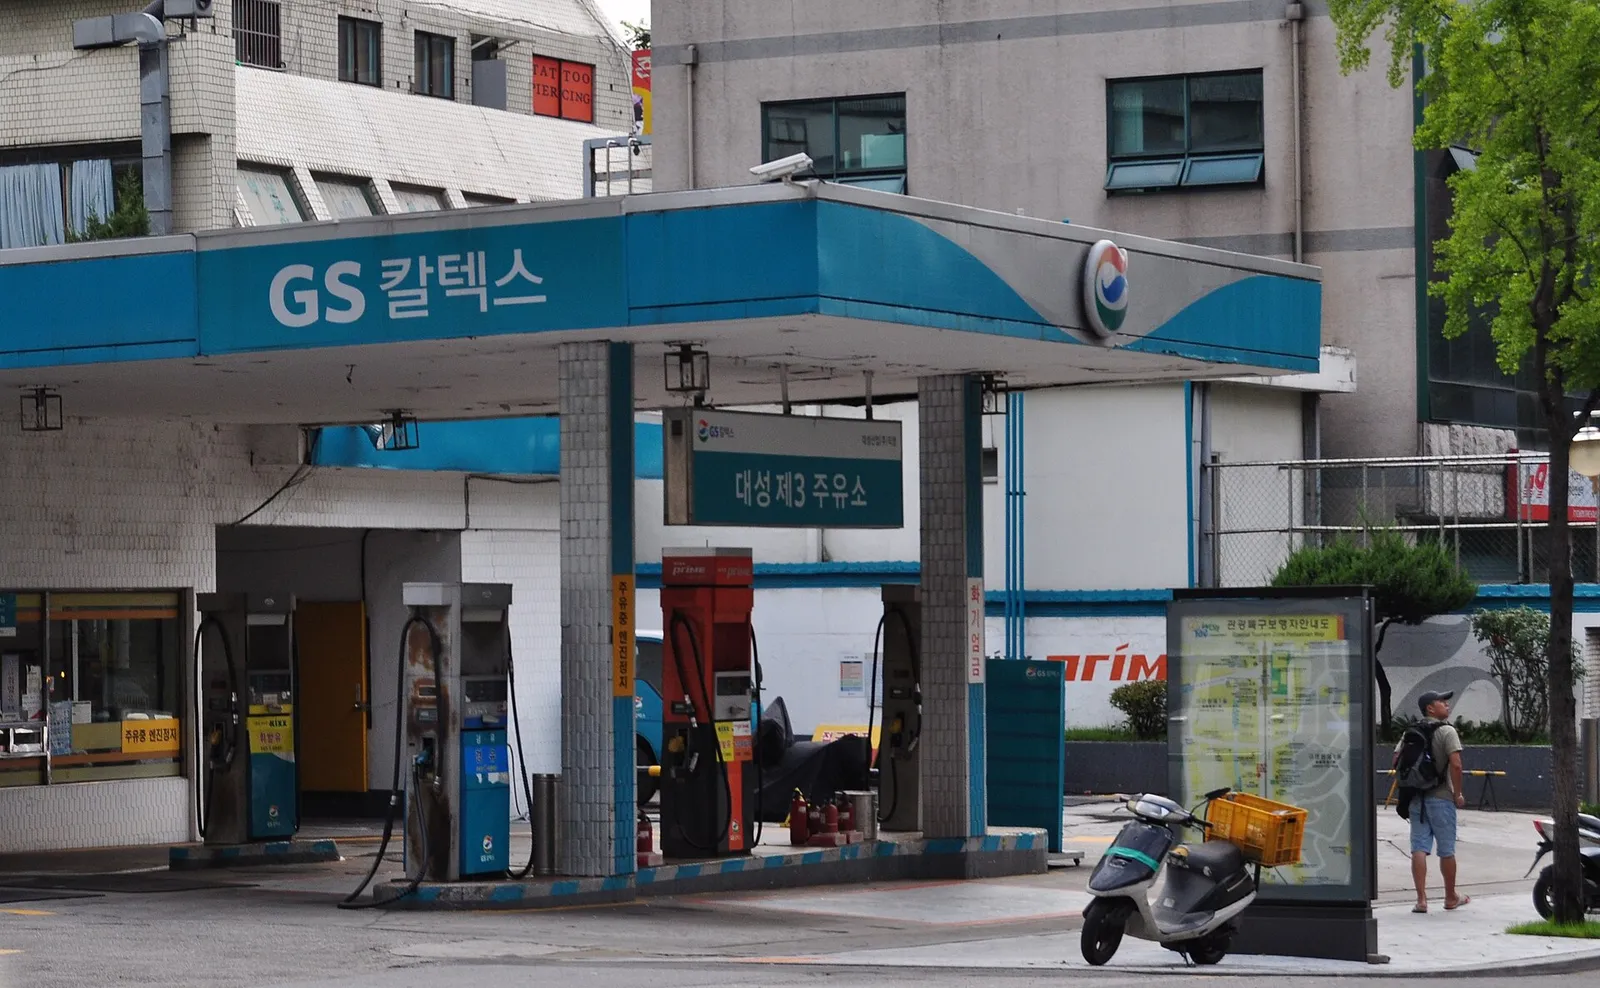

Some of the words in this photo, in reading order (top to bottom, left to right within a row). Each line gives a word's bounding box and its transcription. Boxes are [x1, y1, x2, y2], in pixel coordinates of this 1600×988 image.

[533, 63, 591, 84] TATTOO
[269, 260, 366, 328] GS
[379, 248, 547, 319] 칼텍스
[709, 426, 719, 438] GS
[735, 470, 771, 508] 대성
[776, 471, 806, 508] 제3
[812, 473, 867, 509] 주유소
[618, 581, 628, 625] 주유중
[971, 585, 981, 676] 화기엄금
[618, 631, 628, 689] 엔진정지
[125, 730, 147, 743] 주유중
[149, 727, 177, 742] 엔진정지
